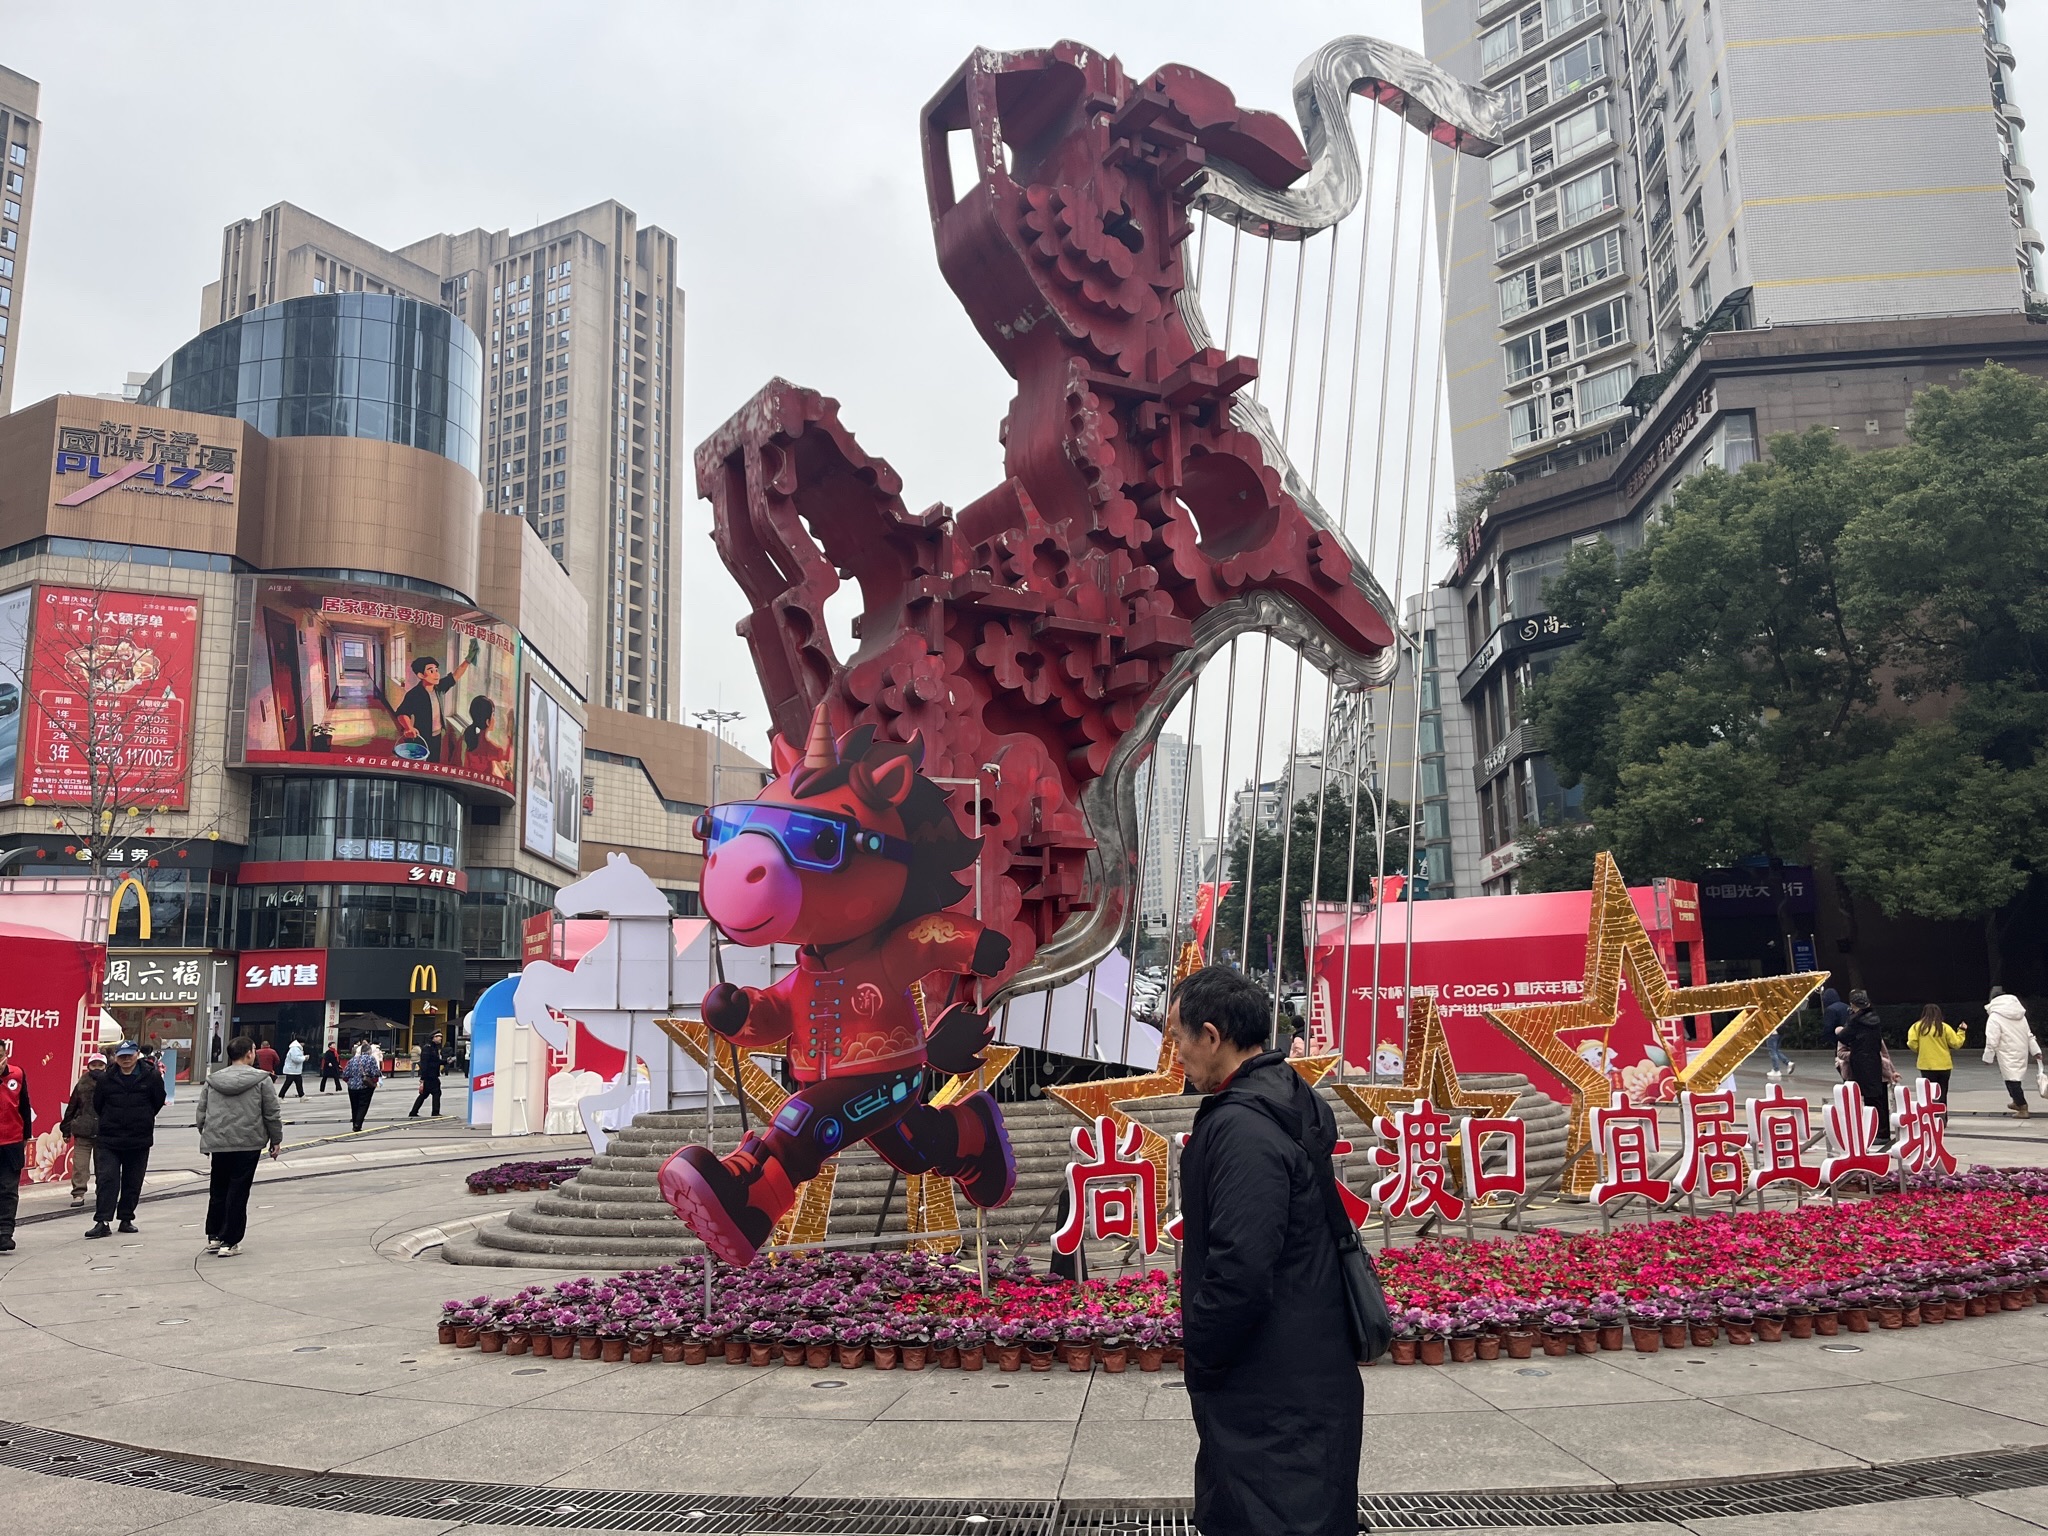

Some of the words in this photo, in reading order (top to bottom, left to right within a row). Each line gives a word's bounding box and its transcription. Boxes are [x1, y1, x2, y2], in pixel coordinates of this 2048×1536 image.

[100, 421, 198, 444] 新天泽
[58, 426, 237, 473] 國際廣場
[55, 452, 234, 506] PLAZA
[121, 484, 234, 504] INTERNATIONAL
[73, 608, 163, 627] 个人大额存单
[322, 596, 444, 629] 居家整洁要打扫
[57, 710, 69, 718] 1年
[48, 721, 76, 730] 18个月
[53, 732, 68, 740] 2年
[49, 744, 69, 762] 3年
[125, 748, 174, 766] 11700元
[408, 866, 457, 885] 乡村基
[1705, 882, 1804, 899] 中国光大行
[103, 960, 200, 987] 周六福
[245, 964, 318, 988] 乡村基
[104, 992, 146, 1001] ZHOU
[150, 992, 173, 1000] LIU
[178, 991, 198, 1000] FU
[0, 1008, 60, 1028] 猪文化节
[1051, 1099, 1525, 1257] 尚渡口
[1589, 1078, 1959, 1205] 宜居宜业城
